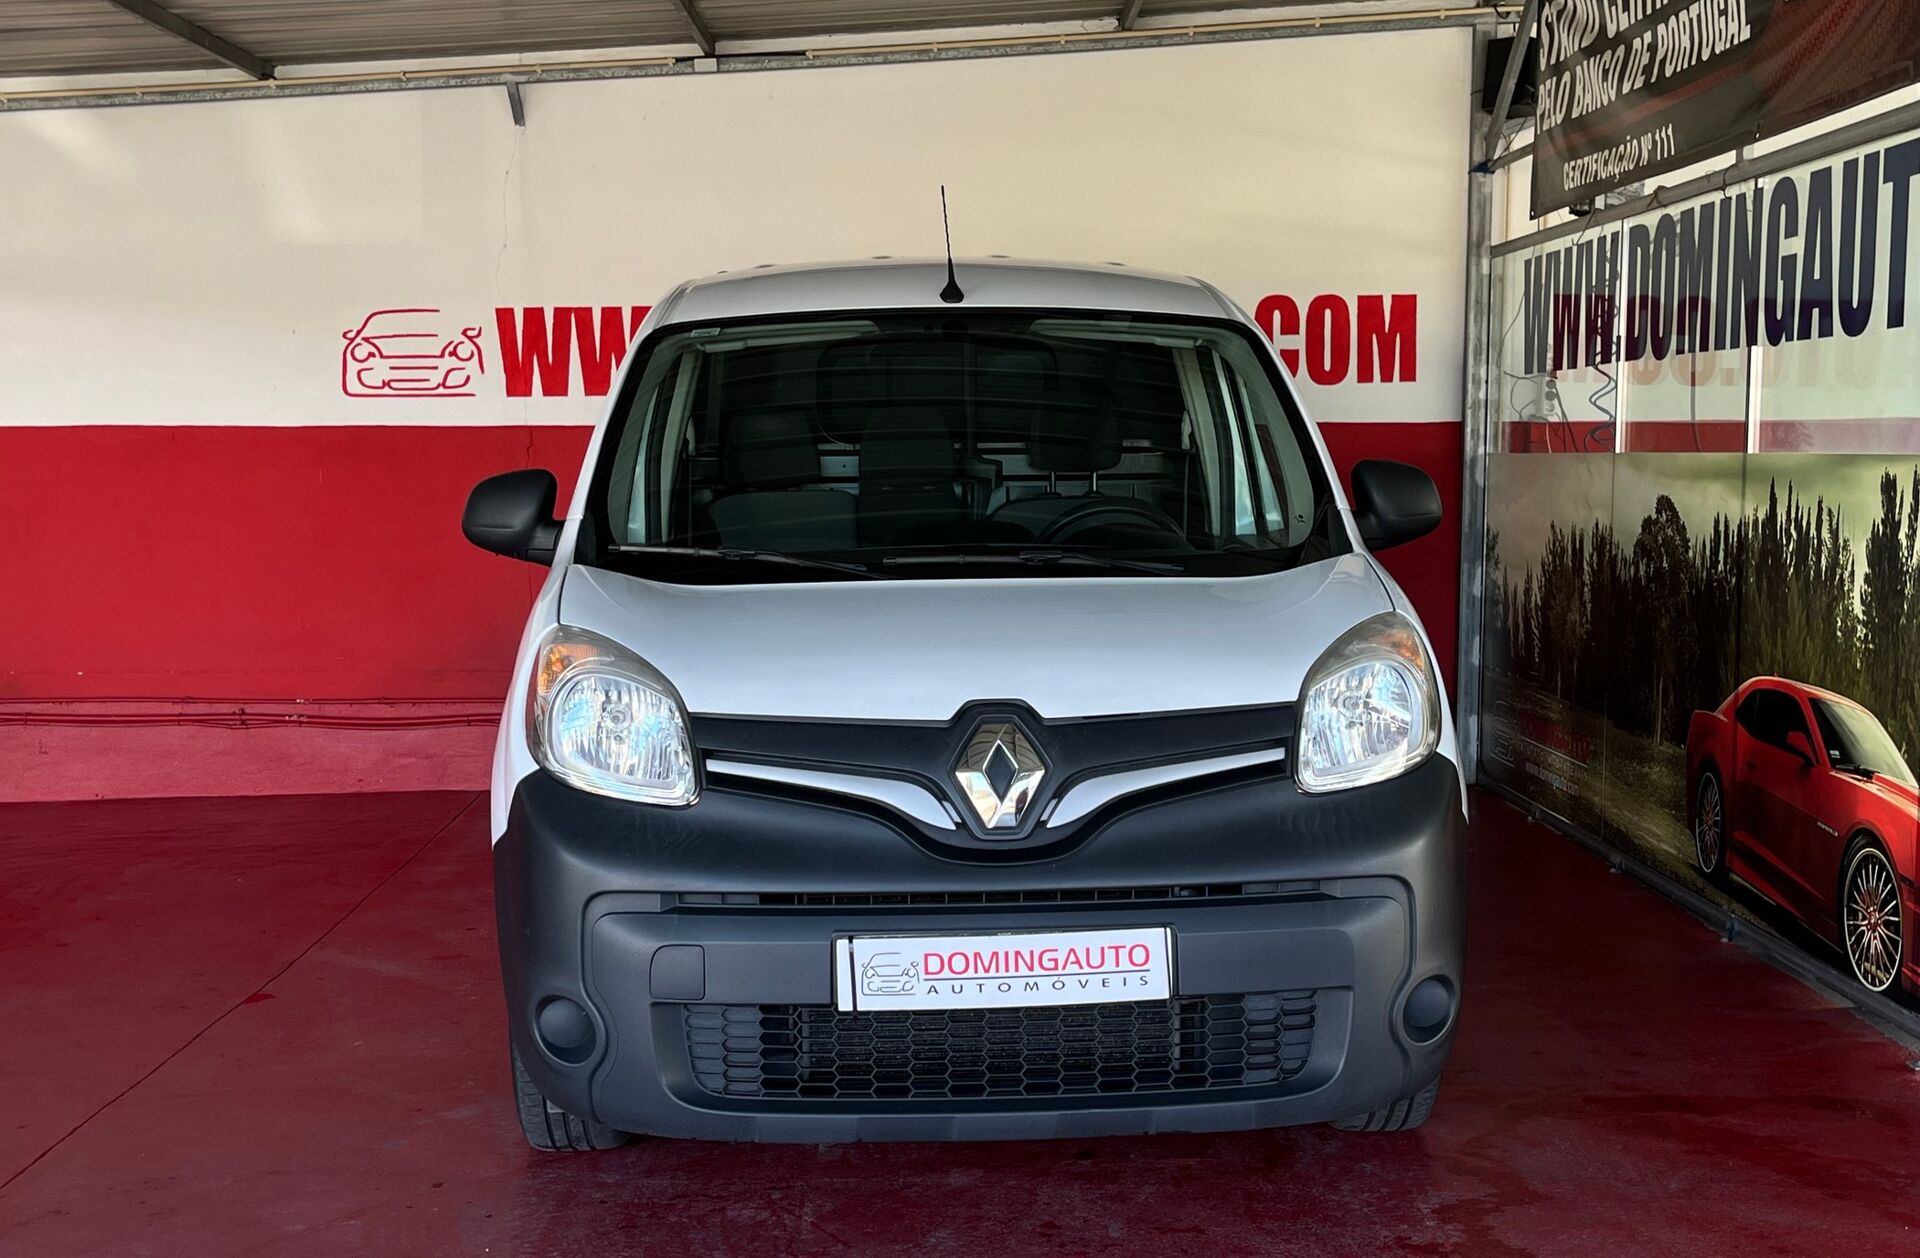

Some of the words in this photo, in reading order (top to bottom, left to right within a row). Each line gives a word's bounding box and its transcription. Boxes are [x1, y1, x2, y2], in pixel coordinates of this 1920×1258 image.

[1537, 71, 1571, 135] PELO
[1572, 44, 1626, 119] BANCO
[1622, 30, 1652, 95] DE
[1650, 0, 1751, 83] PORTUGAL
[1563, 134, 1639, 191] CERTIFICAÇÃO
[1655, 123, 1675, 160] 111
[923, 943, 1151, 976] DOMINGAUTO
[926, 975, 1149, 995] AUTOMÓVEIS
